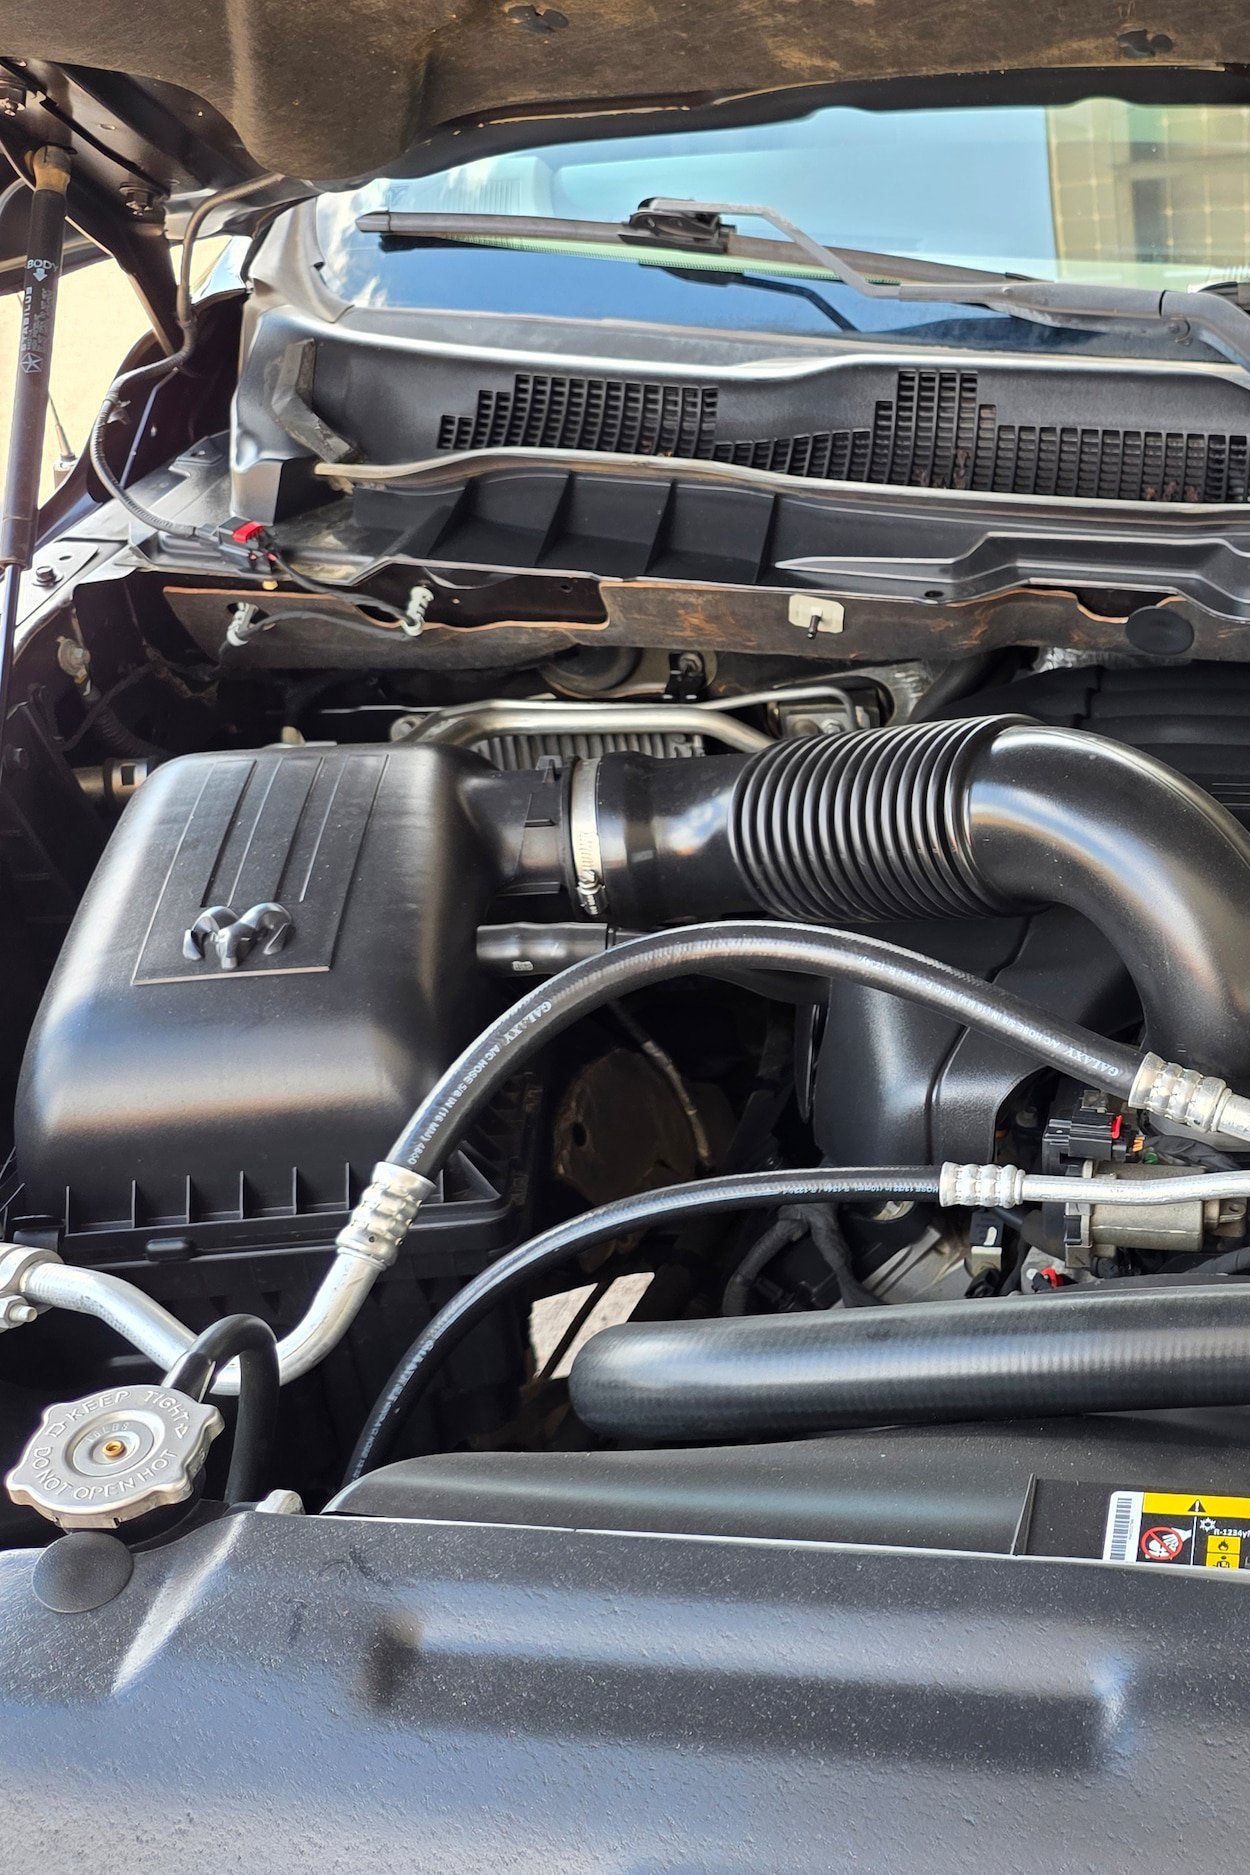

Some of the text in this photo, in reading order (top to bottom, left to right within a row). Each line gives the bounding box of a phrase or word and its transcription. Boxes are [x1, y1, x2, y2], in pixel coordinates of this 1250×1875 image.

[27, 259, 59, 272] BODY
[21, 286, 33, 352] STABILUS
[1016, 1024, 1043, 1042] HOSE
[1063, 1042, 1120, 1077] GALAXY
[463, 1059, 488, 1085] HOSE
[455, 1083, 468, 1099] 5/8
[449, 1096, 457, 1109] IN
[434, 1106, 450, 1122] (16
[420, 1121, 440, 1142] MM)
[915, 1184, 939, 1194] HOSE
[66, 1390, 191, 1422] KEEP TIGHT
[33, 1446, 179, 1501] DO NOT OPEN HOT
[1213, 1528, 1250, 1540] R-1234yf
